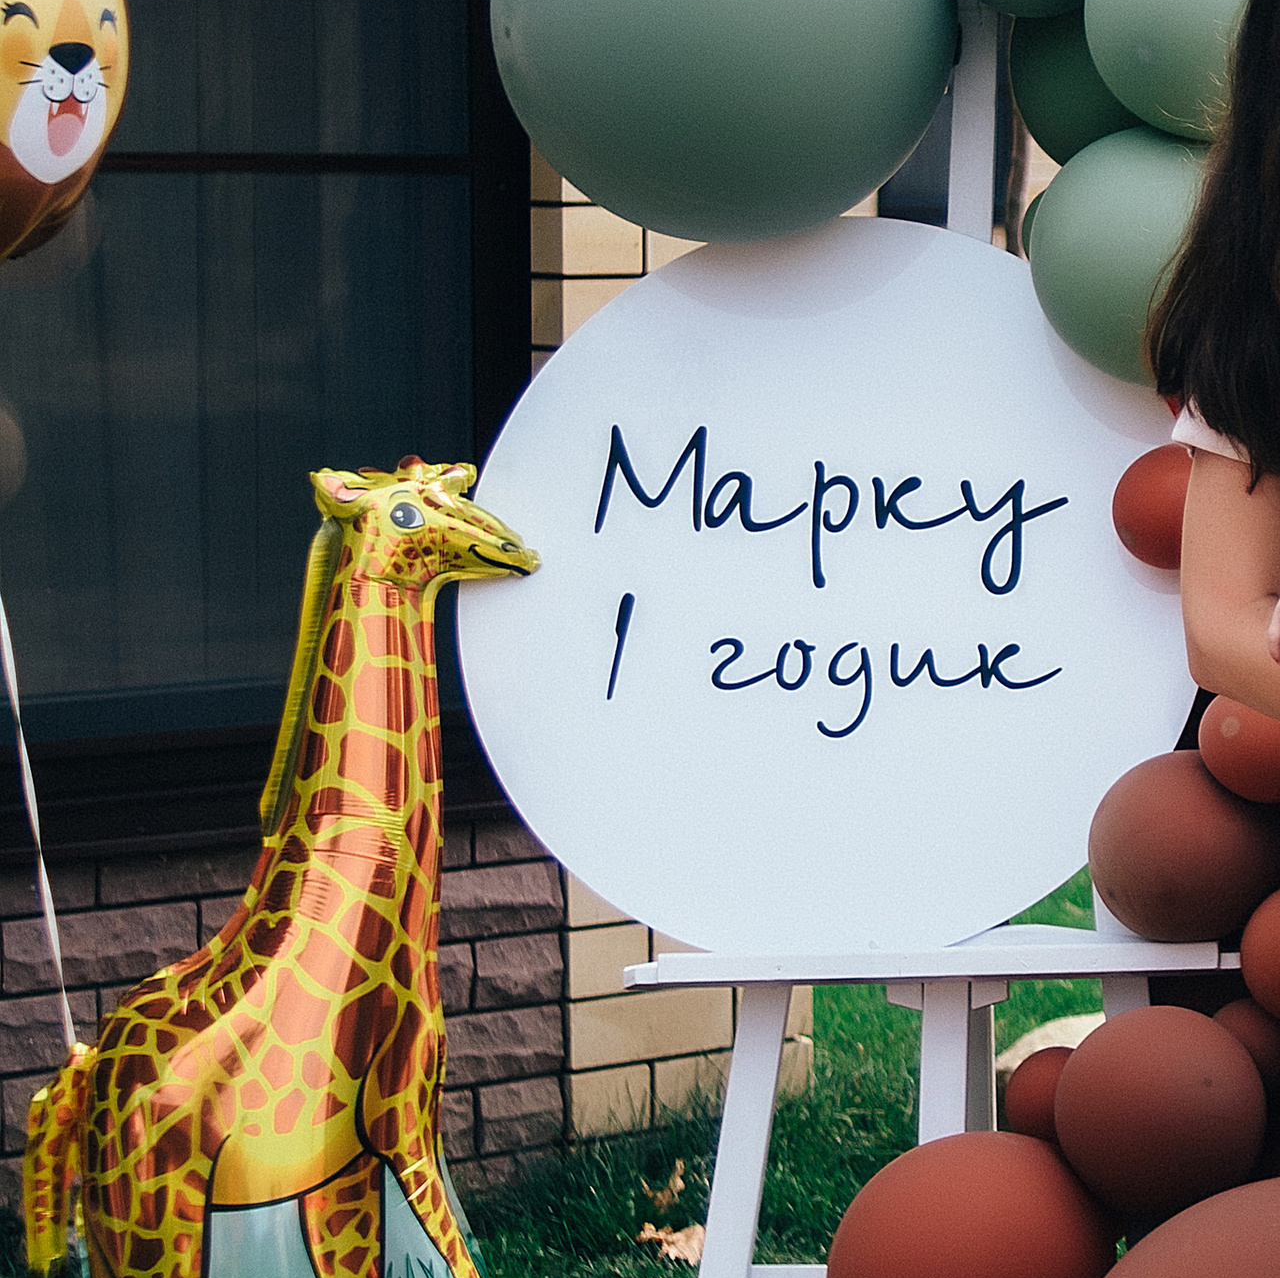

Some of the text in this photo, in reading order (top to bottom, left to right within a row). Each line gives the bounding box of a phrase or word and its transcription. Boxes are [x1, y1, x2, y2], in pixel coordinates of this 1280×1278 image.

[594, 424, 1069, 596] Марку
[606, 592, 1063, 739] 1 годик
